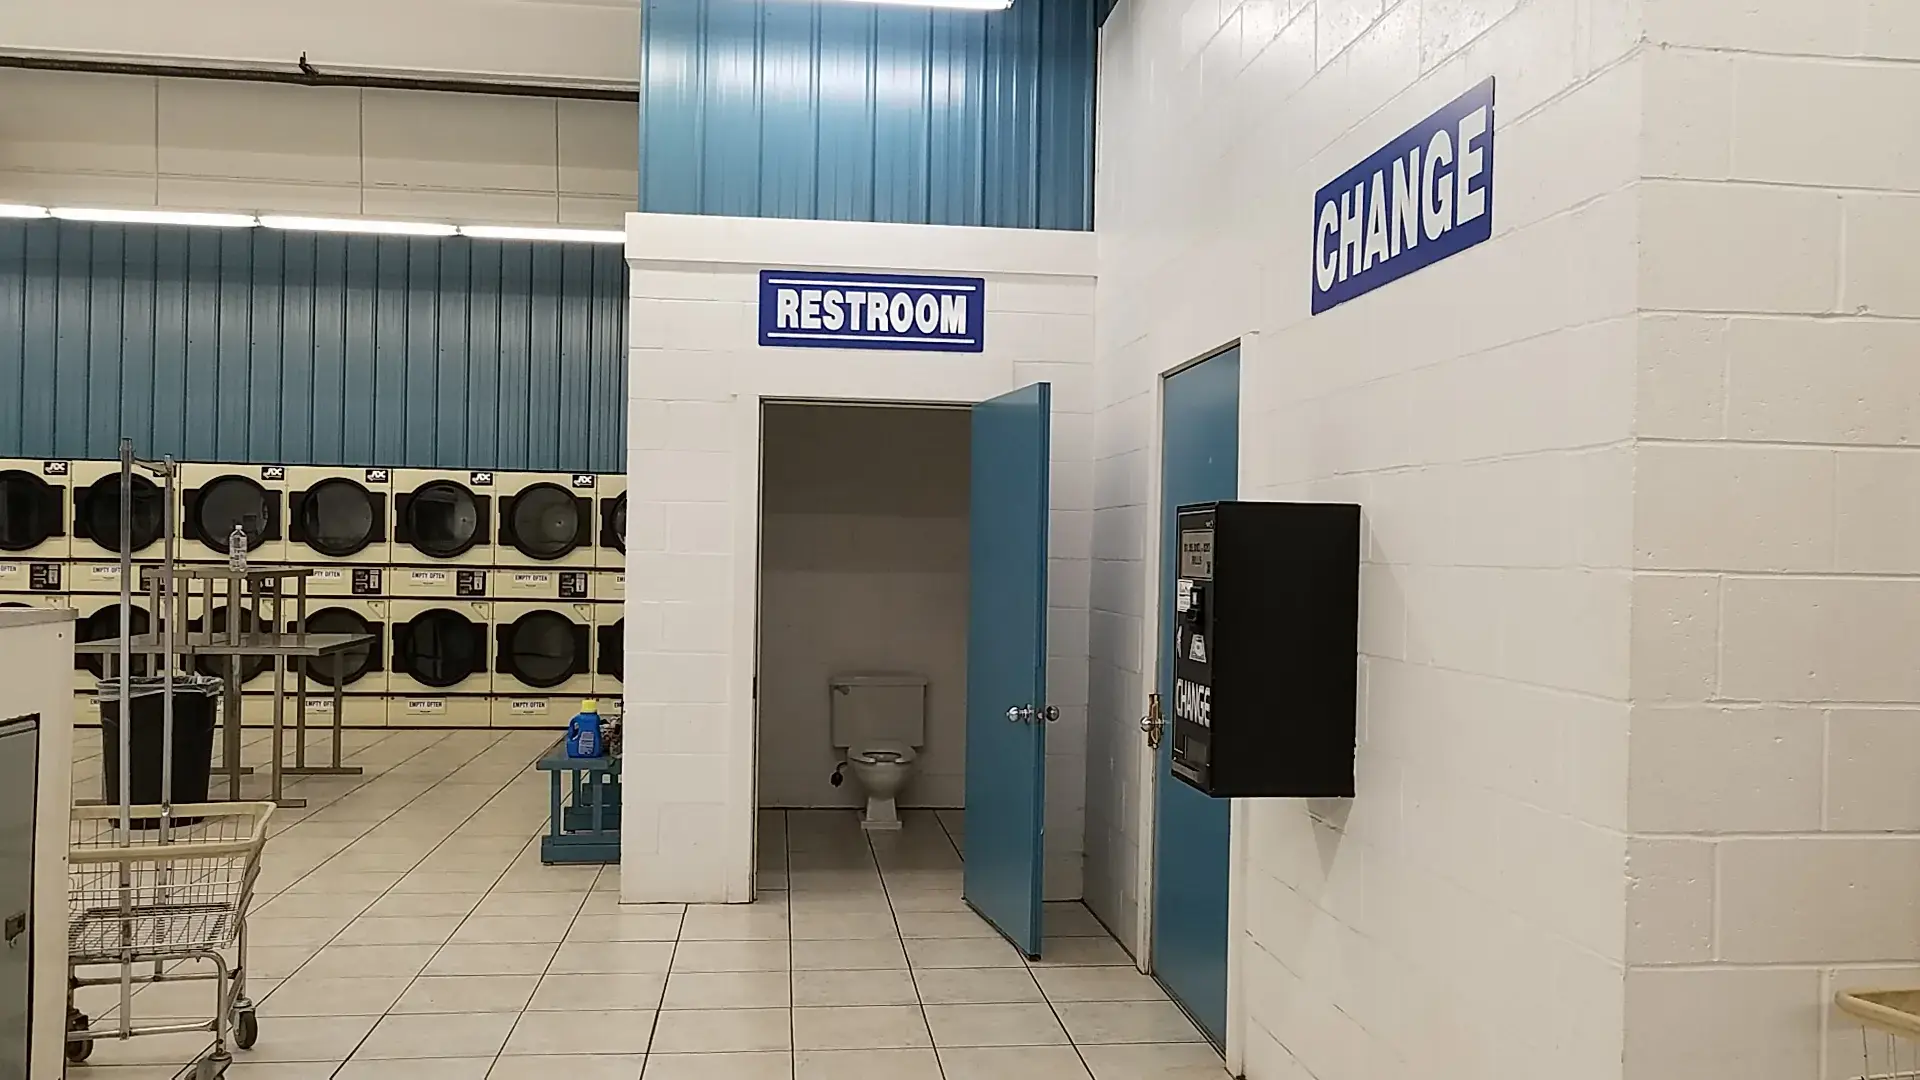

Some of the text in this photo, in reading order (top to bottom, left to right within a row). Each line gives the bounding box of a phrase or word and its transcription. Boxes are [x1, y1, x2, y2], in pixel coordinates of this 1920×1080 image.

[1316, 105, 1487, 292] CHANGE
[777, 288, 967, 334] RESTROOM
[1176, 678, 1211, 728] CHANGE
